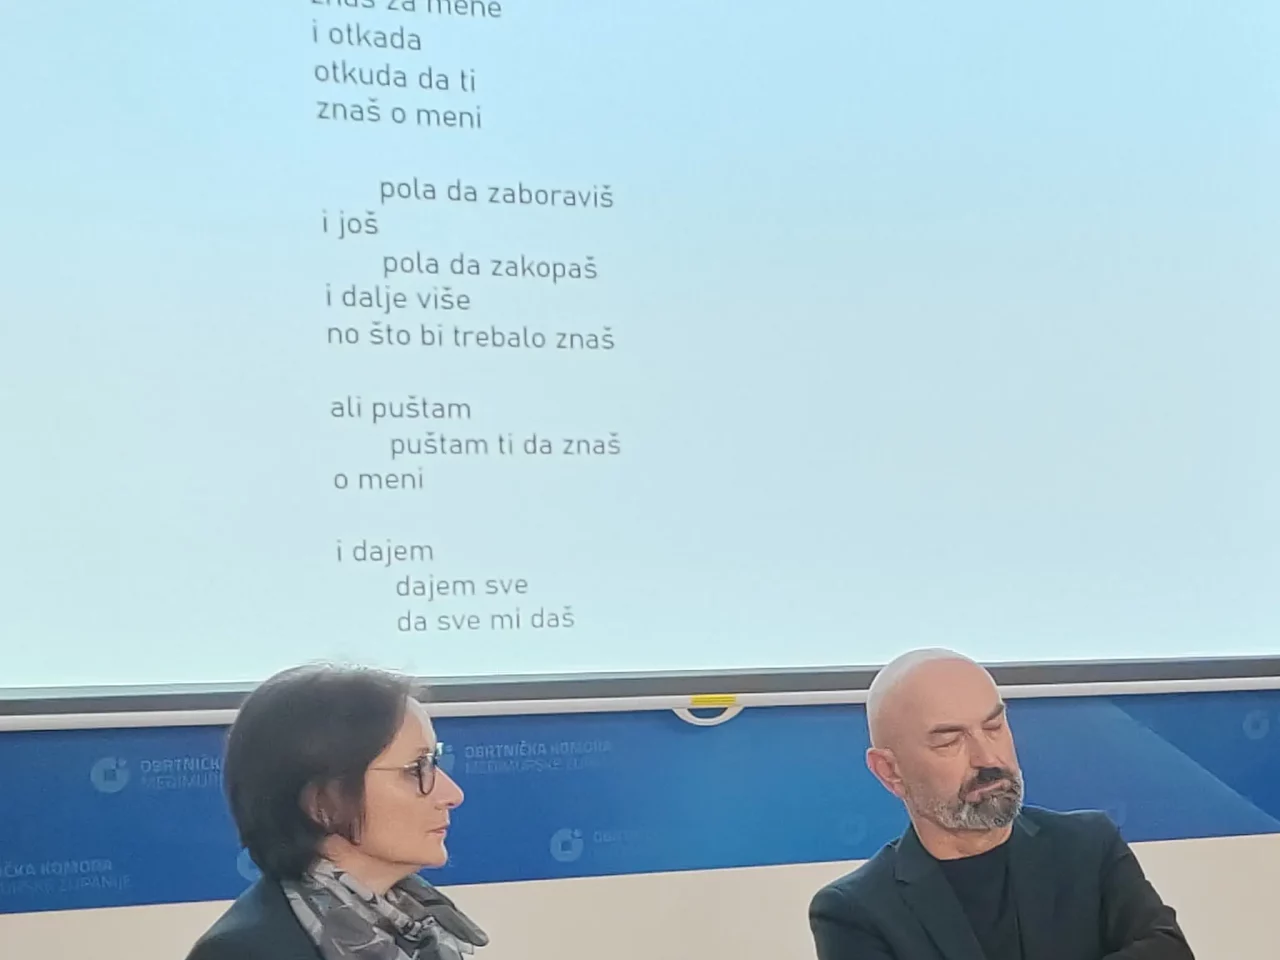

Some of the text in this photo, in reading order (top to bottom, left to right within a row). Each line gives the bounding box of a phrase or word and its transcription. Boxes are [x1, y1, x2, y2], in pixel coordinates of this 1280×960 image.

[427, 0, 502, 18] mene
[312, 18, 421, 51] i otkada
[314, 59, 475, 93] otkuda da ti
[316, 96, 481, 130] znaš o meni
[380, 176, 614, 208] pola da zaboraviš
[322, 209, 380, 240] i još
[383, 250, 598, 286] pola da zakopaš
[326, 283, 471, 316] i dalje više
[328, 320, 615, 350] no što bi trebalo znaš
[330, 395, 471, 425] ali puštam
[390, 430, 621, 460] puštam ti da znaš
[333, 466, 423, 490] o meni
[337, 538, 434, 568] i dajem
[396, 574, 528, 603] dajem sve
[397, 605, 575, 632] da sve mi daš
[140, 754, 220, 773] OBRTNIČK
